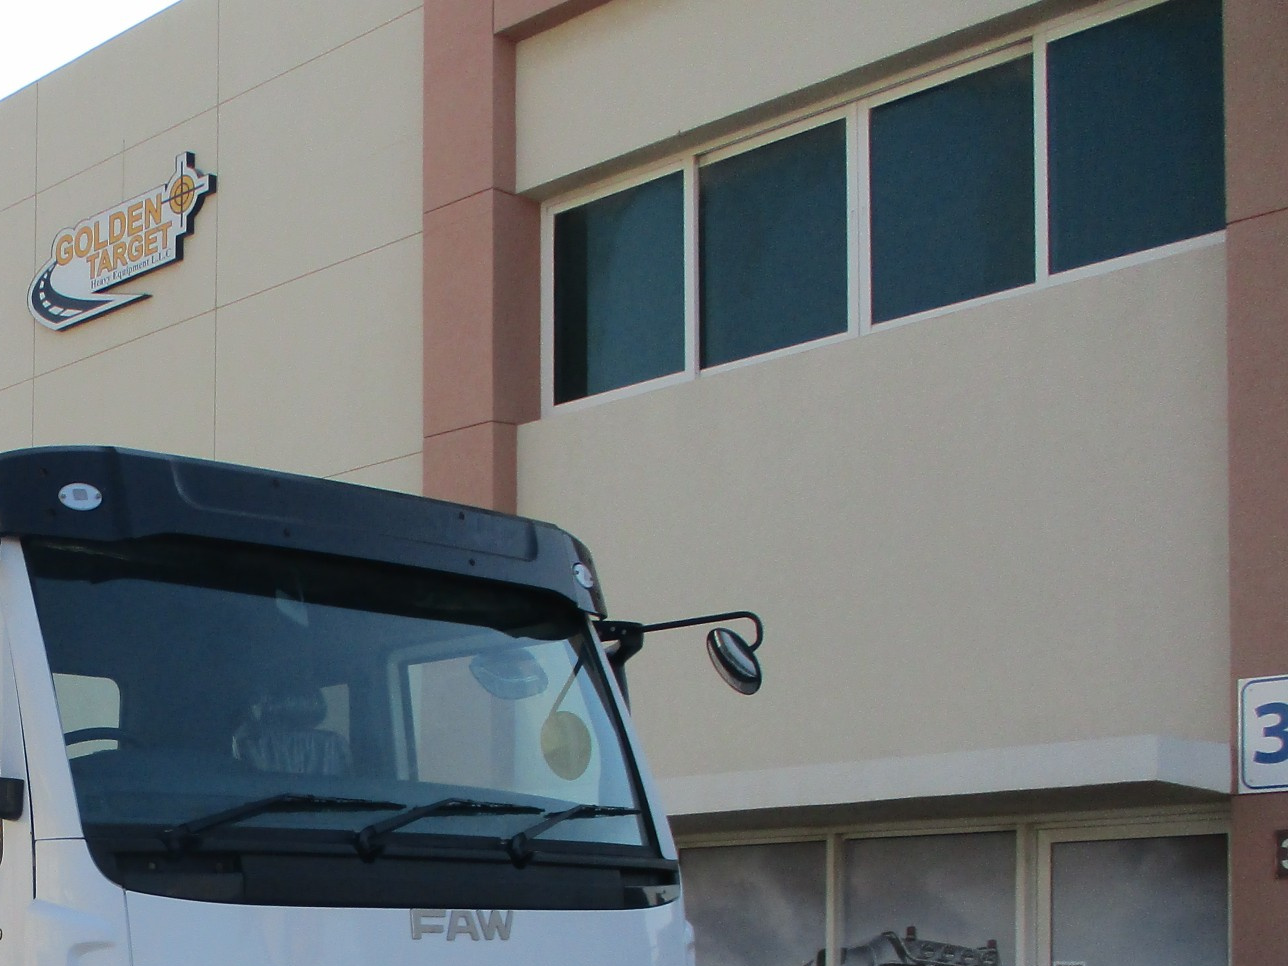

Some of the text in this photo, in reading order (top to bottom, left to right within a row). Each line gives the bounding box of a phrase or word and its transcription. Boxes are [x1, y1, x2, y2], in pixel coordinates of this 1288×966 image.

[56, 193, 162, 266] GOLDEN
[86, 220, 172, 280] TARGET
[91, 277, 111, 289] Heavy
[113, 259, 150, 280] Equipment
[410, 908, 513, 941] FAW
